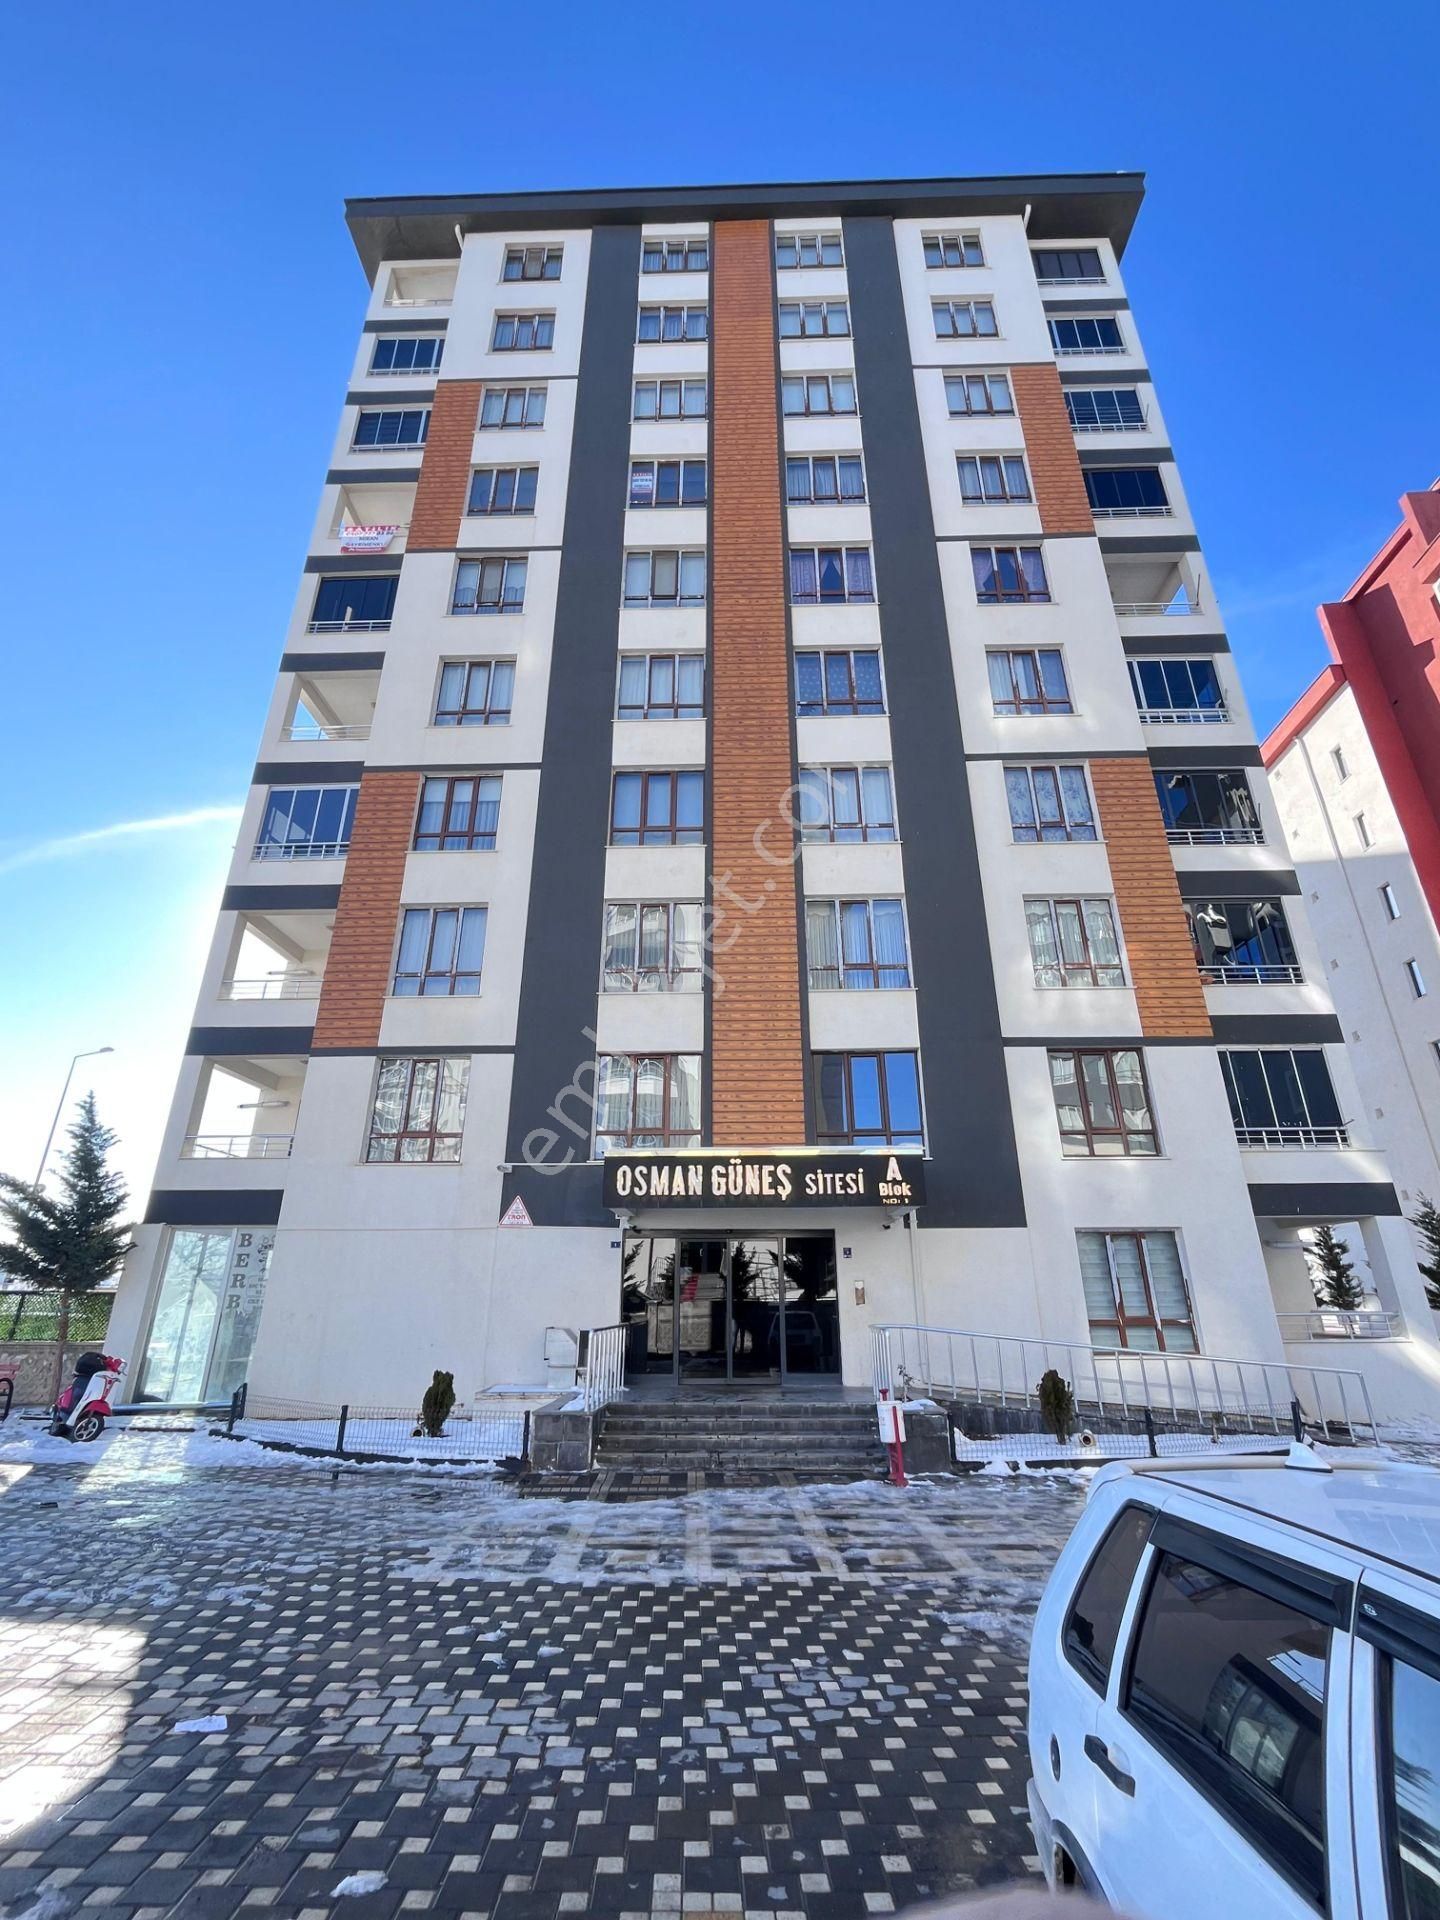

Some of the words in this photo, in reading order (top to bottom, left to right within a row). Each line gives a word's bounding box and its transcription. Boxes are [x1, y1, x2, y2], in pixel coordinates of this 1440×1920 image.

[616, 1164, 703, 1197] OSMAN
[711, 1158, 793, 1201] GÜNEŞ
[804, 1168, 865, 1195] SİTESİ
[886, 1156, 903, 1181] A
[879, 1182, 912, 1196] Blok
